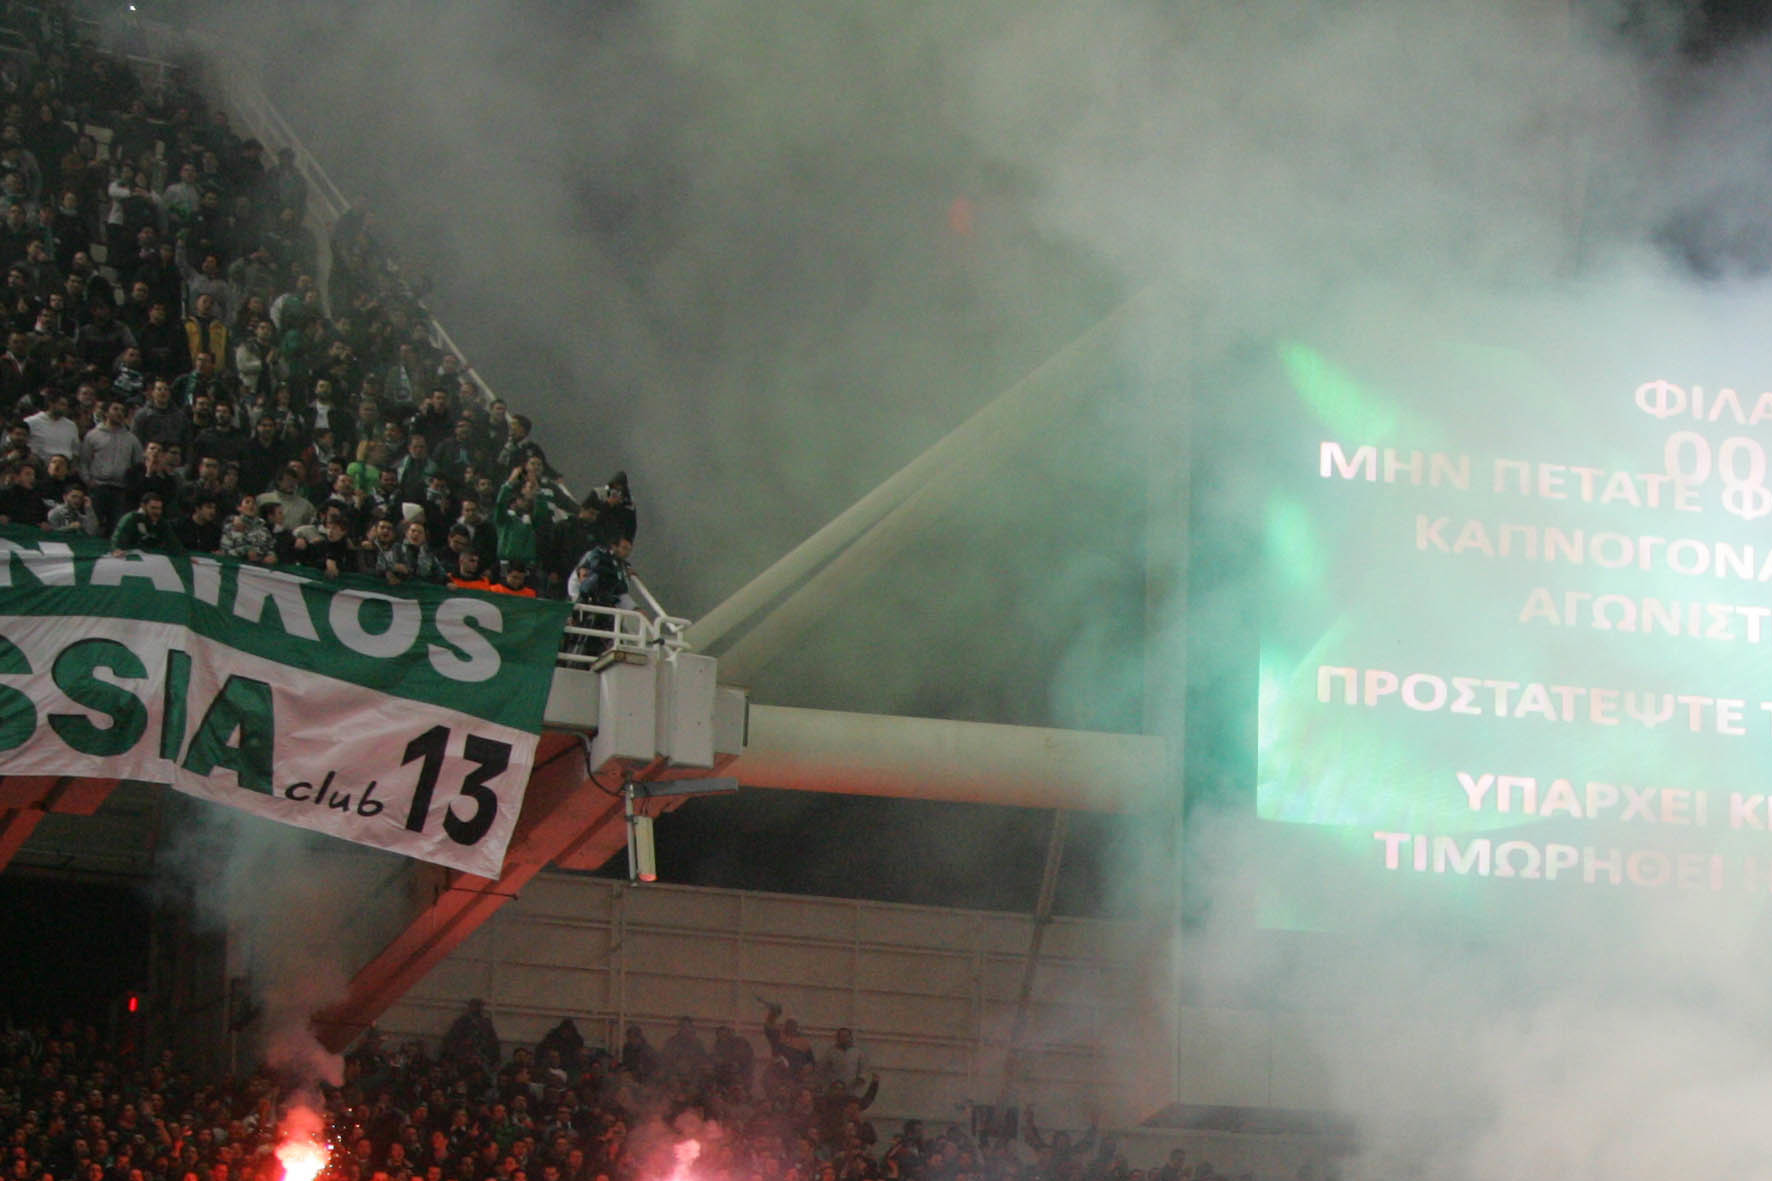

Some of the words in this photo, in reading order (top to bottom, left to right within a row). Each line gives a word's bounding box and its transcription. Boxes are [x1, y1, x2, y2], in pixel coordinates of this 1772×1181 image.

[1319, 440, 1471, 491] ΜΗΝ
[1493, 458, 1703, 513] ΠΕΤΑΤΕ
[1316, 664, 1747, 736] ΠΡΟΣΤΑΤΕΨΤΕ
[285, 771, 385, 818] club
[400, 725, 513, 846] 13
[1456, 771, 1707, 826] ΥΠΑΡΧΕΙ
[1374, 830, 1723, 892] ΤΙΜΩΡΗΘΕΙ
